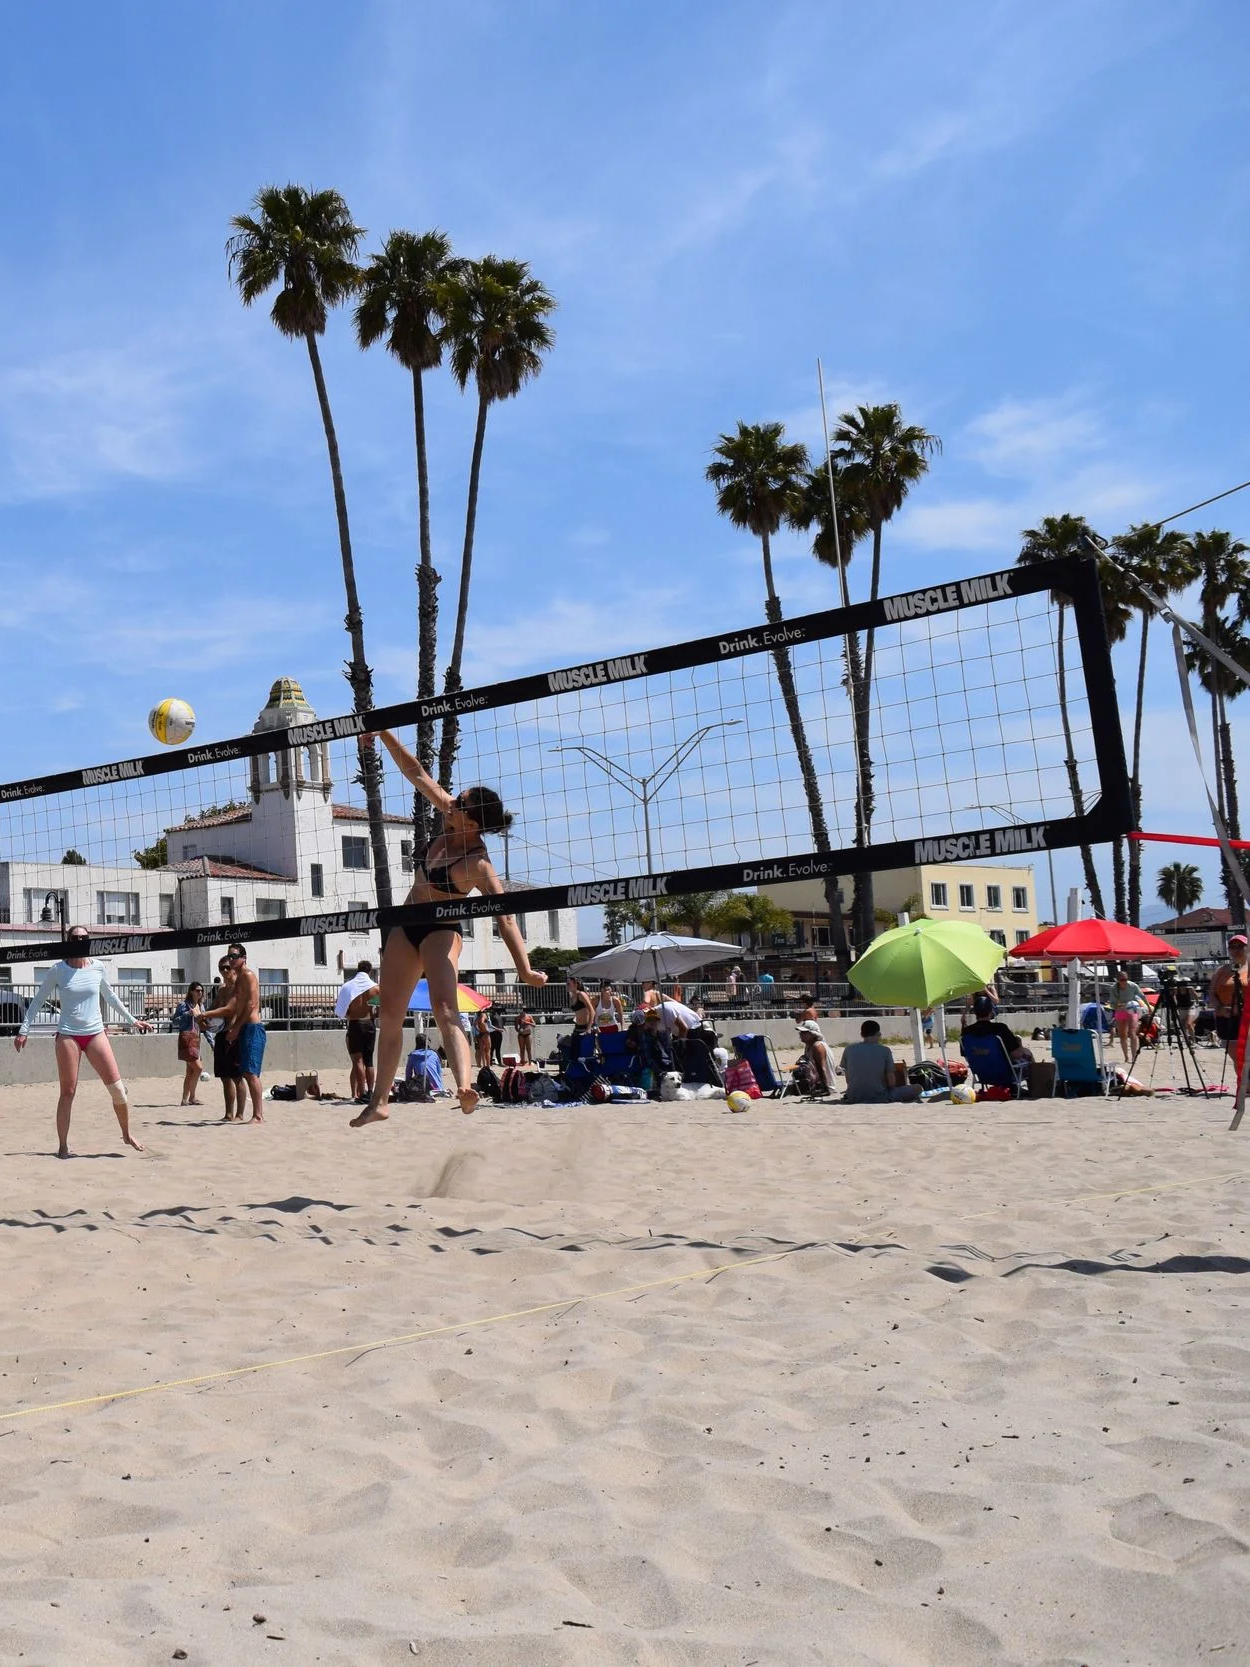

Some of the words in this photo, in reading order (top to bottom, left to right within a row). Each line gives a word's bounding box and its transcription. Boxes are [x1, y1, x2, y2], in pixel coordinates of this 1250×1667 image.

[883, 585, 959, 621] MUSCLE
[960, 573, 1013, 604] MILK
[718, 634, 762, 654] Drink.
[547, 663, 606, 693] MUSCLE
[606, 655, 649, 680] MILK
[421, 699, 454, 717] Drink.
[287, 723, 333, 746] MUSCLE
[333, 715, 367, 736] MILK
[81, 765, 119, 786] MUSCLE
[118, 760, 145, 779] MILK
[915, 831, 992, 864] MUSCLE
[994, 825, 1048, 853] MILK
[743, 866, 787, 883] Drink.
[567, 882, 627, 906] MUSCLE
[628, 876, 669, 899] MILK
[300, 915, 346, 936] MUSCLE
[347, 911, 379, 930] MILK
[435, 904, 470, 918] Drink.
[88, 937, 127, 956] MUSCLE
[126, 935, 152, 952] MILK
